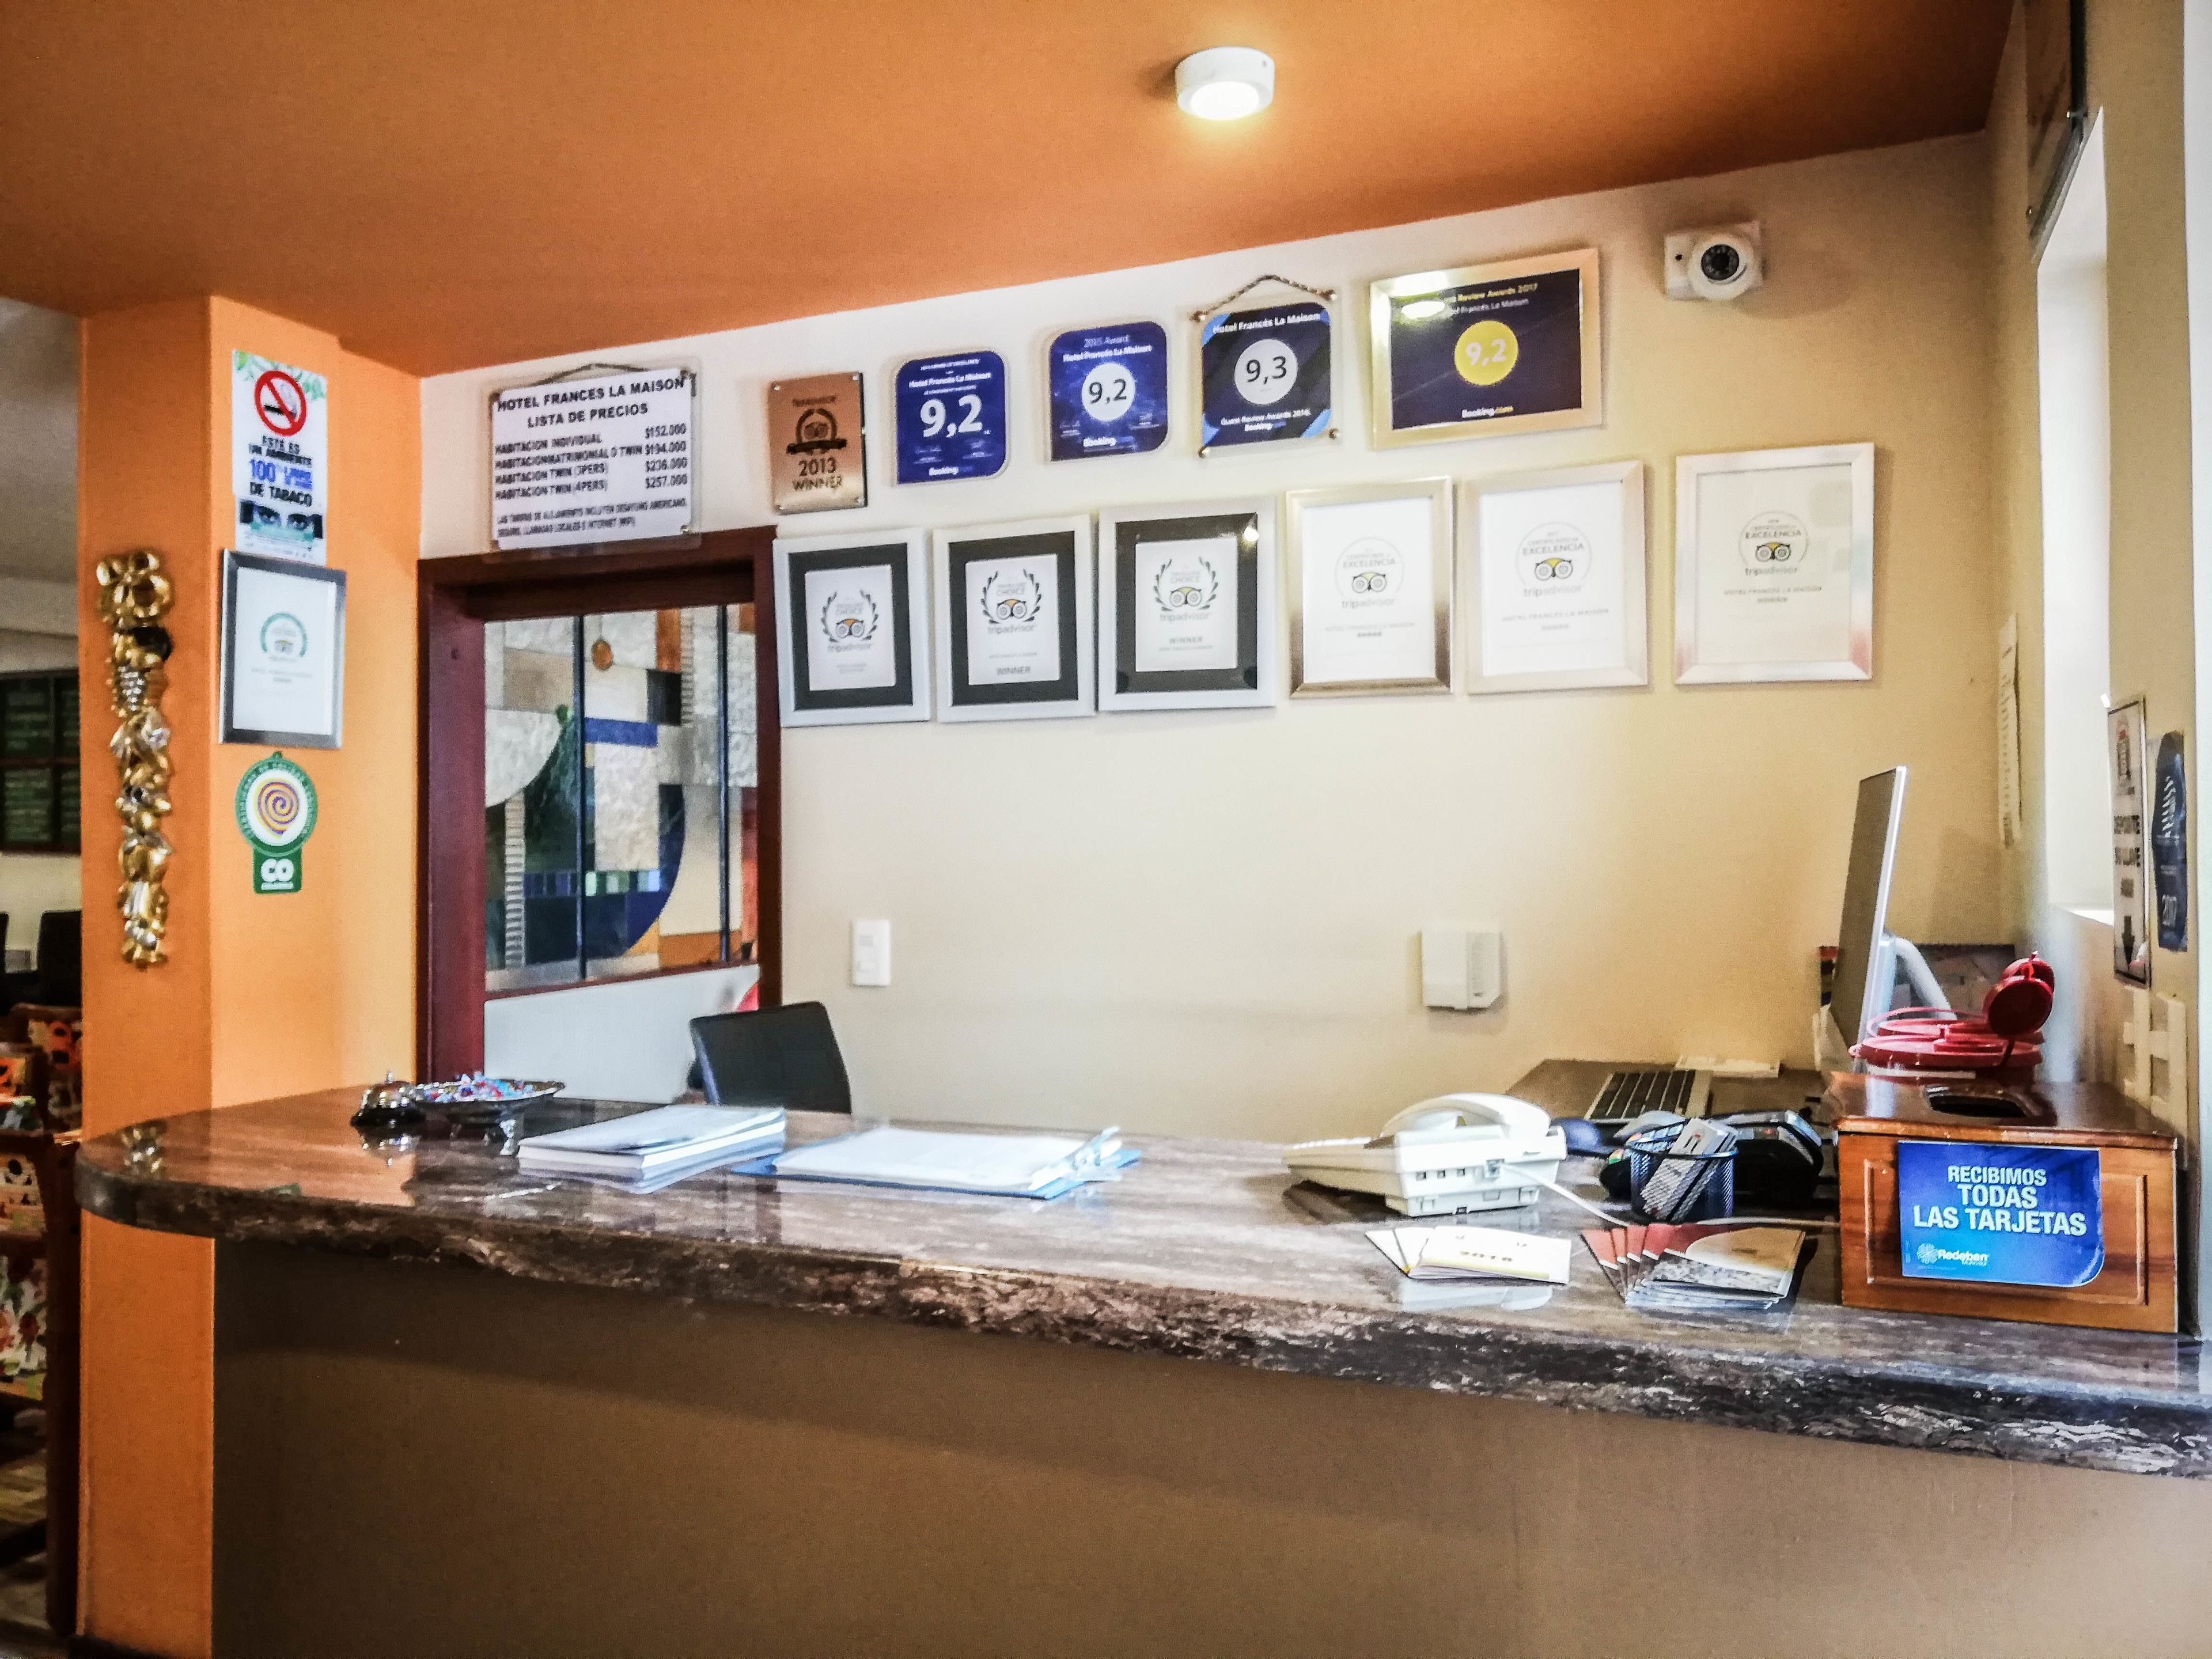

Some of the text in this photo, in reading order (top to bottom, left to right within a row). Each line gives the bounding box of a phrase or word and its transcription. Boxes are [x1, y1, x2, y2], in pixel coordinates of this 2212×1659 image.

[1213, 322, 1237, 334] Hotel
[1274, 317, 1286, 325] La
[1287, 313, 1321, 323] Maison
[1063, 353, 1083, 362] Hotel
[1465, 338, 1506, 366] 9,2
[1246, 356, 1287, 384] 9,3
[497, 377, 684, 412] HOTEL FRANCES LA MAISON
[1088, 379, 1127, 404] 9,2
[527, 403, 648, 428] LISTA DE PRECIOS
[921, 394, 983, 438] 9,2
[645, 423, 687, 439] $152.000
[619, 445, 642, 457] TWIN
[550, 467, 572, 477] TWIN
[798, 456, 836, 476] 2013
[250, 482, 264, 497] DE
[548, 484, 571, 495] TWIN
[645, 474, 688, 489] $257.000
[792, 475, 842, 491] WINNER
[1745, 529, 1802, 539] EXCELENCIA
[1522, 543, 1584, 556] EXCELENCIA
[1343, 558, 1395, 569] EXCELENCIA
[1169, 636, 1203, 645] WINNER
[997, 666, 1031, 676] WINNER
[1948, 1165, 2047, 1187] RECIBIMOS
[1957, 1183, 2039, 1209] TODAS
[1914, 1205, 2088, 1236] LAS TARJETAS
[1938, 1249, 1988, 1262] Redeban
